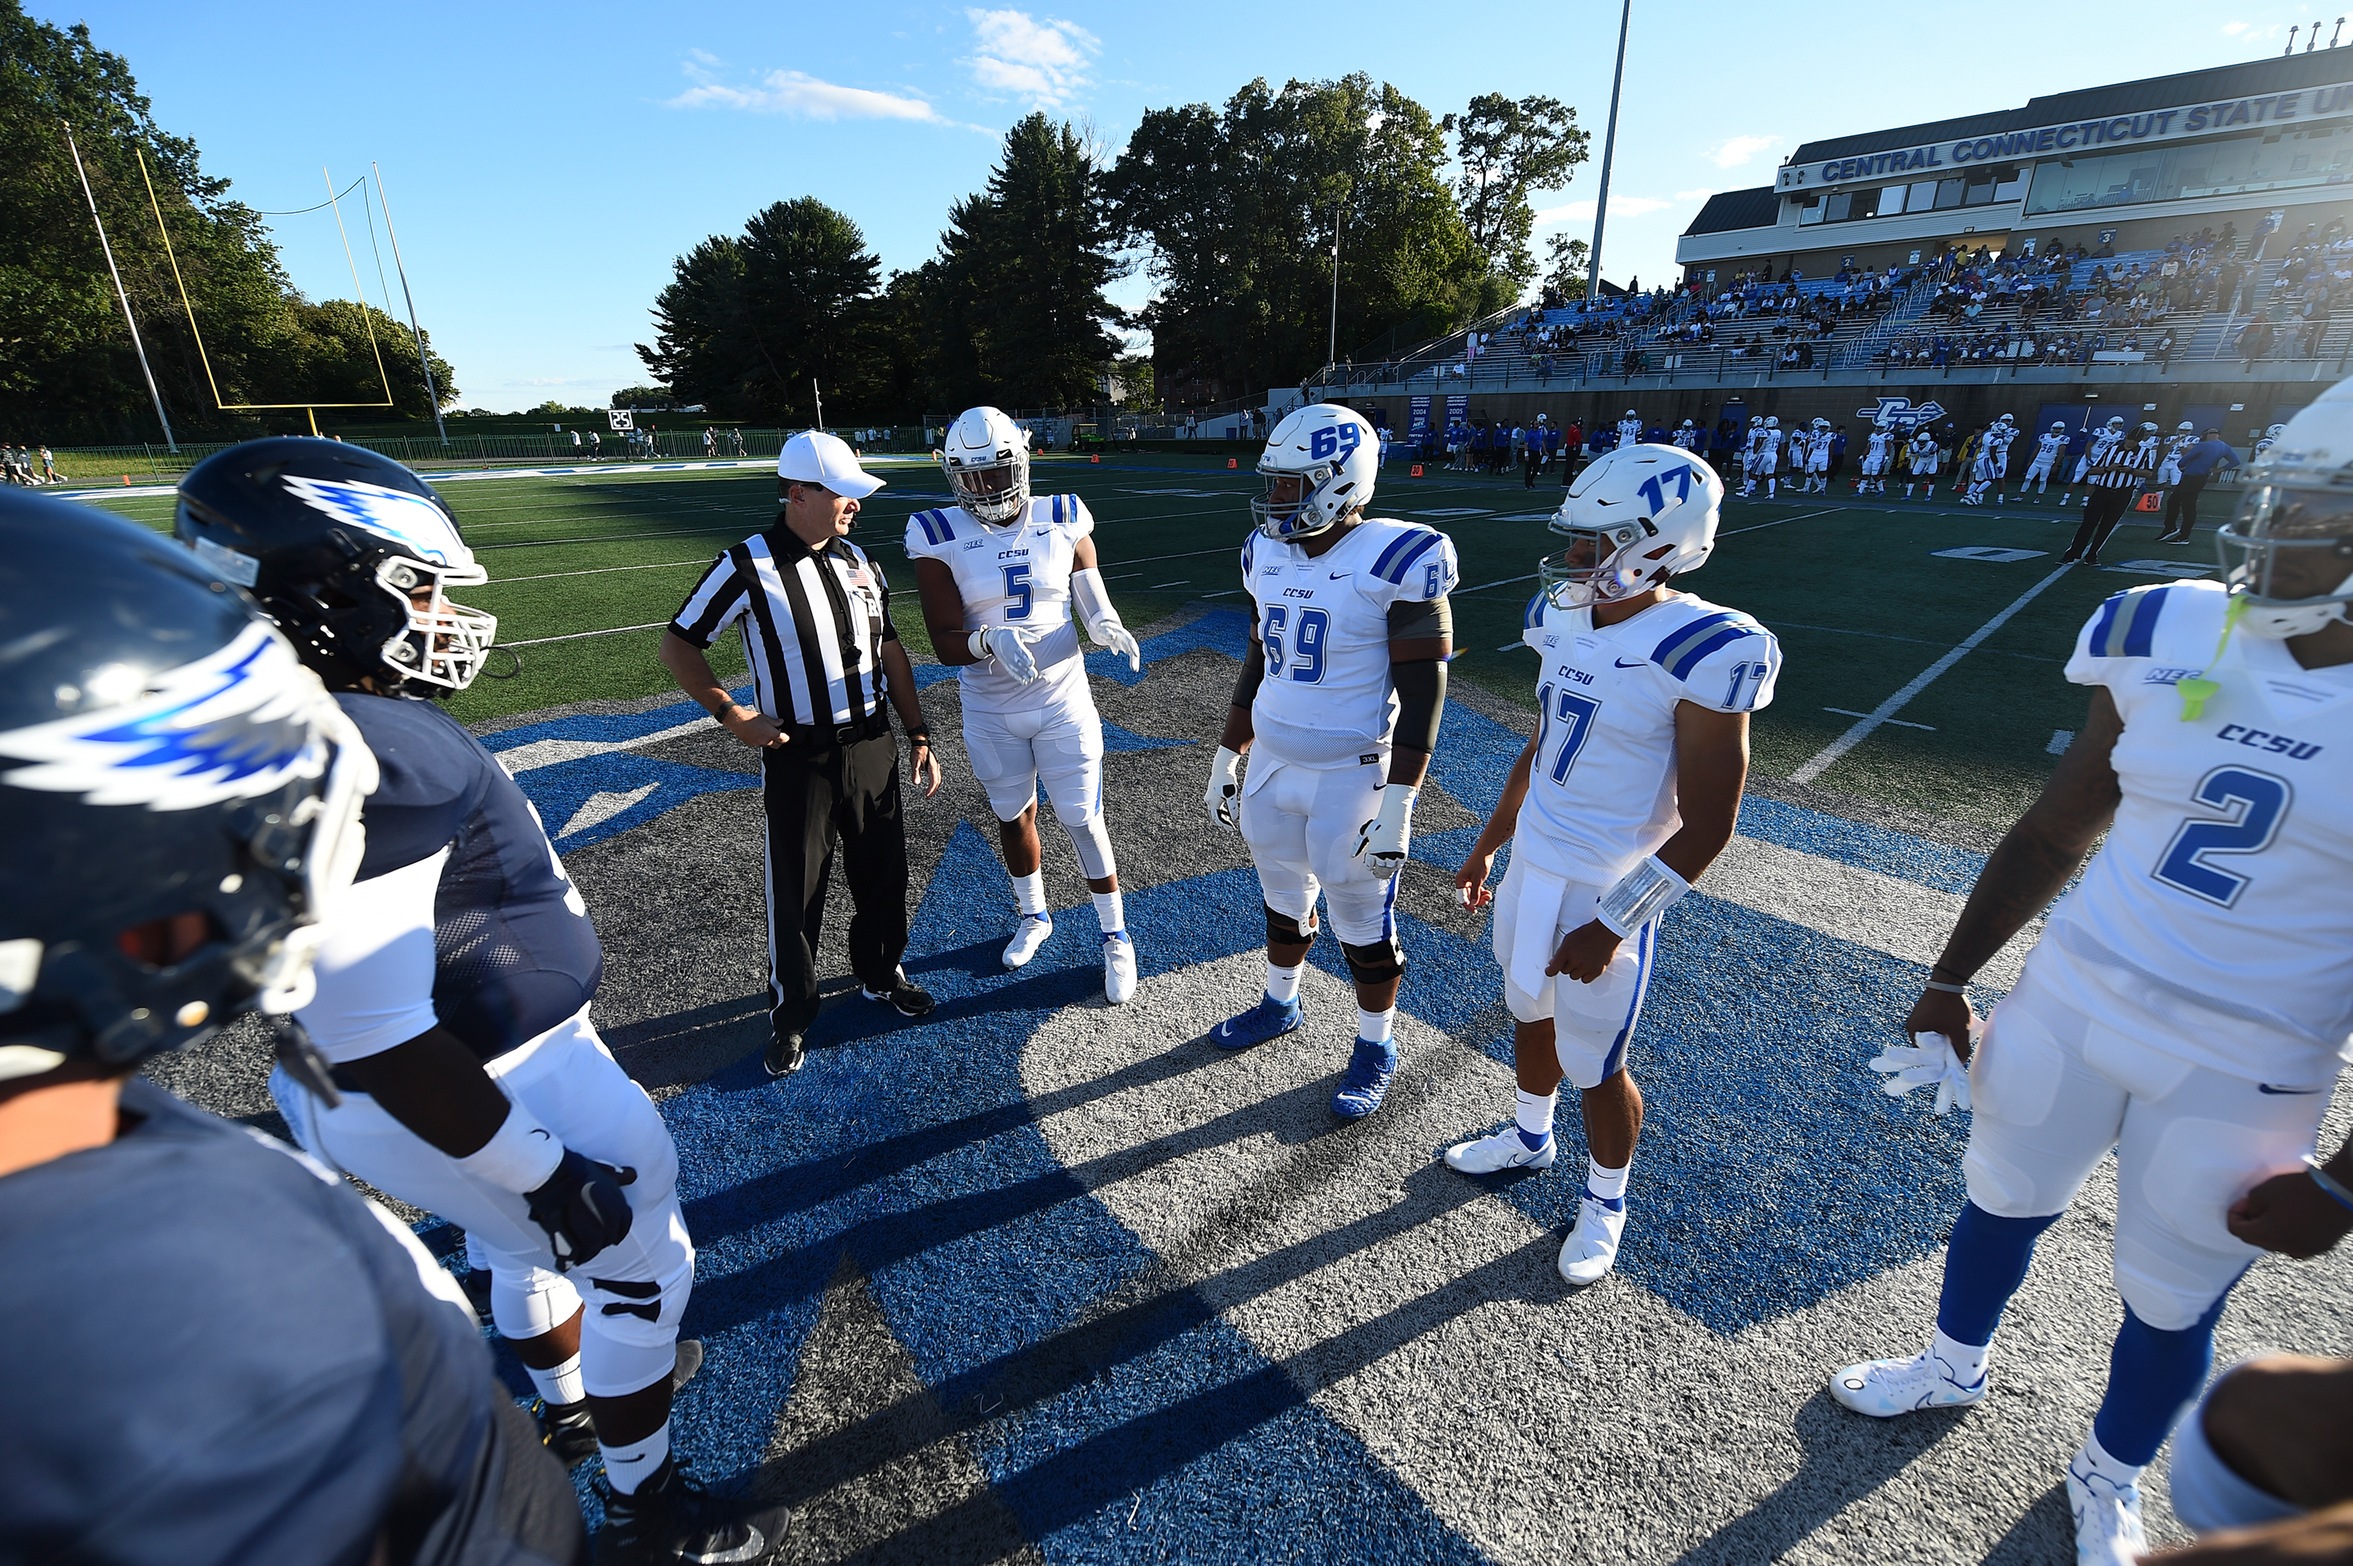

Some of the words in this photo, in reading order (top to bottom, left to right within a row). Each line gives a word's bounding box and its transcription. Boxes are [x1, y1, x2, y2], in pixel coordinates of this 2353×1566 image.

[1822, 146, 1942, 182] CENTRAL
[1952, 110, 2179, 163] CONNECTICUT
[2185, 94, 2301, 132] STATE
[2102, 233, 2111, 243] 3
[1844, 258, 1851, 267] 2
[613, 412, 630, 428] 25
[1310, 423, 1361, 460] 69
[971, 455, 987, 463] CCSU
[1637, 463, 1692, 517] 17
[2146, 495, 2157, 508] 50
[963, 538, 983, 550] NEC
[997, 548, 1029, 560] CCSU
[1261, 565, 1280, 575] NEC
[1000, 562, 1035, 622] 5
[1283, 587, 1314, 599] CCSU
[1264, 603, 1332, 685] 69
[1558, 665, 1595, 686] CCSU
[1721, 660, 1769, 711] 17
[1536, 681, 1602, 787] 17
[2217, 723, 2323, 761] CCSU
[1362, 755, 1378, 763] 3XL
[2151, 763, 2293, 910] 2
